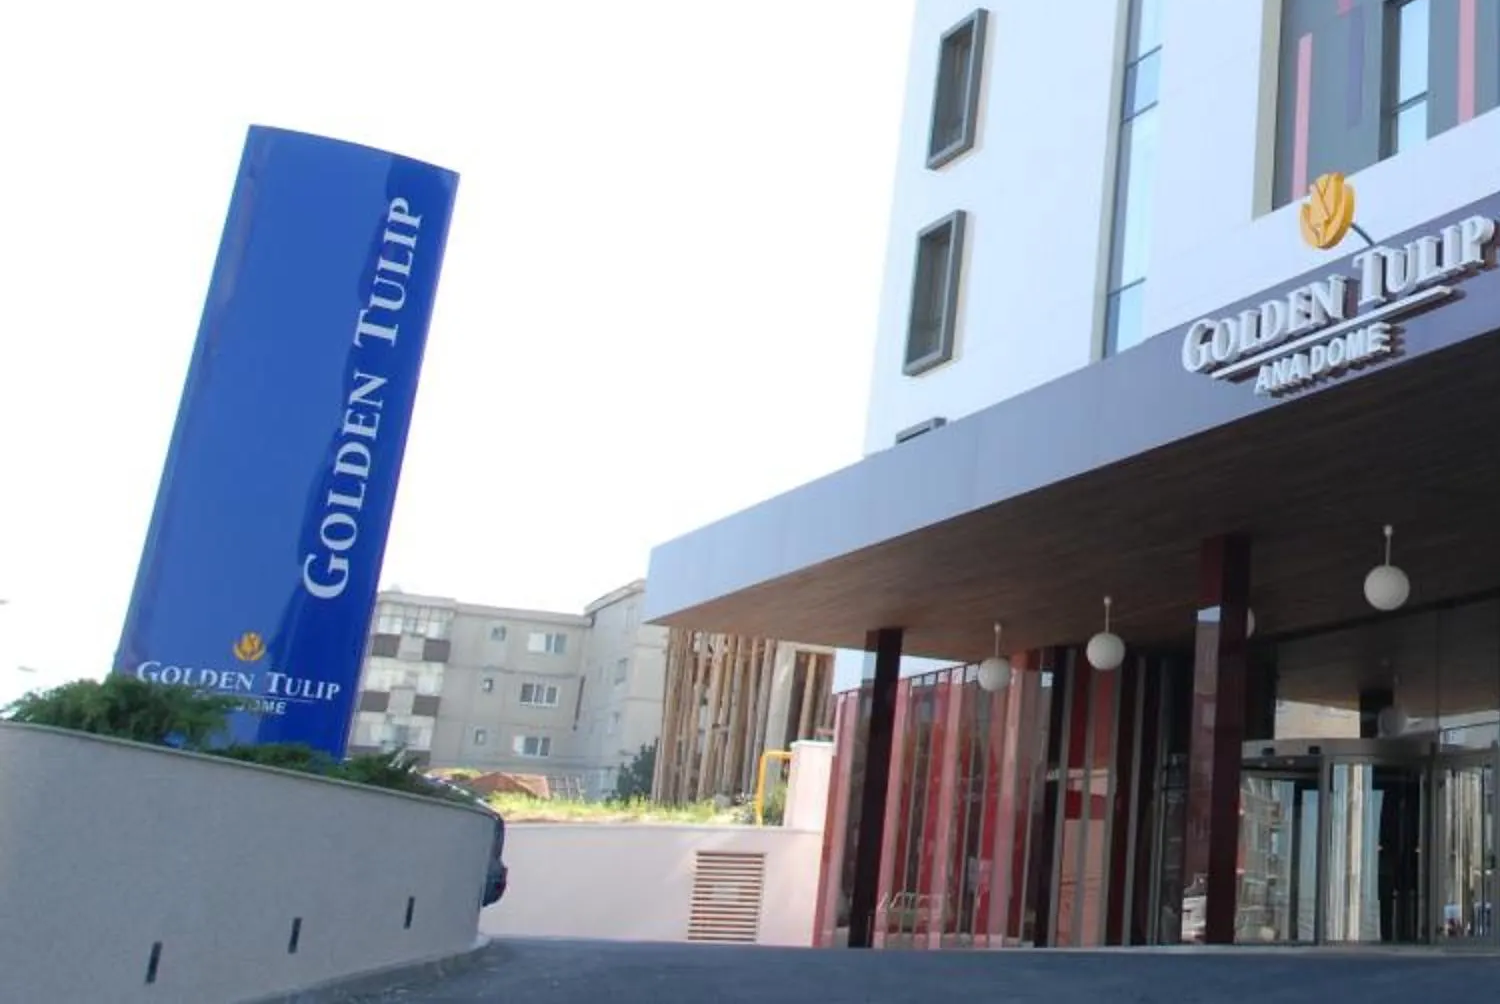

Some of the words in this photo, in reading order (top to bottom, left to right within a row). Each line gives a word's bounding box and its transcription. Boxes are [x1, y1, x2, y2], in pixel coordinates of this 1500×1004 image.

[1182, 274, 1347, 373] GOLDEN
[1352, 215, 1496, 305] TULIP
[303, 372, 388, 599] GOLDEN
[354, 196, 424, 347] TULIP
[1254, 360, 1309, 396] ANA
[1311, 322, 1392, 377] DOME
[136, 660, 256, 691] GOLDEN
[267, 671, 340, 701] TULIP
